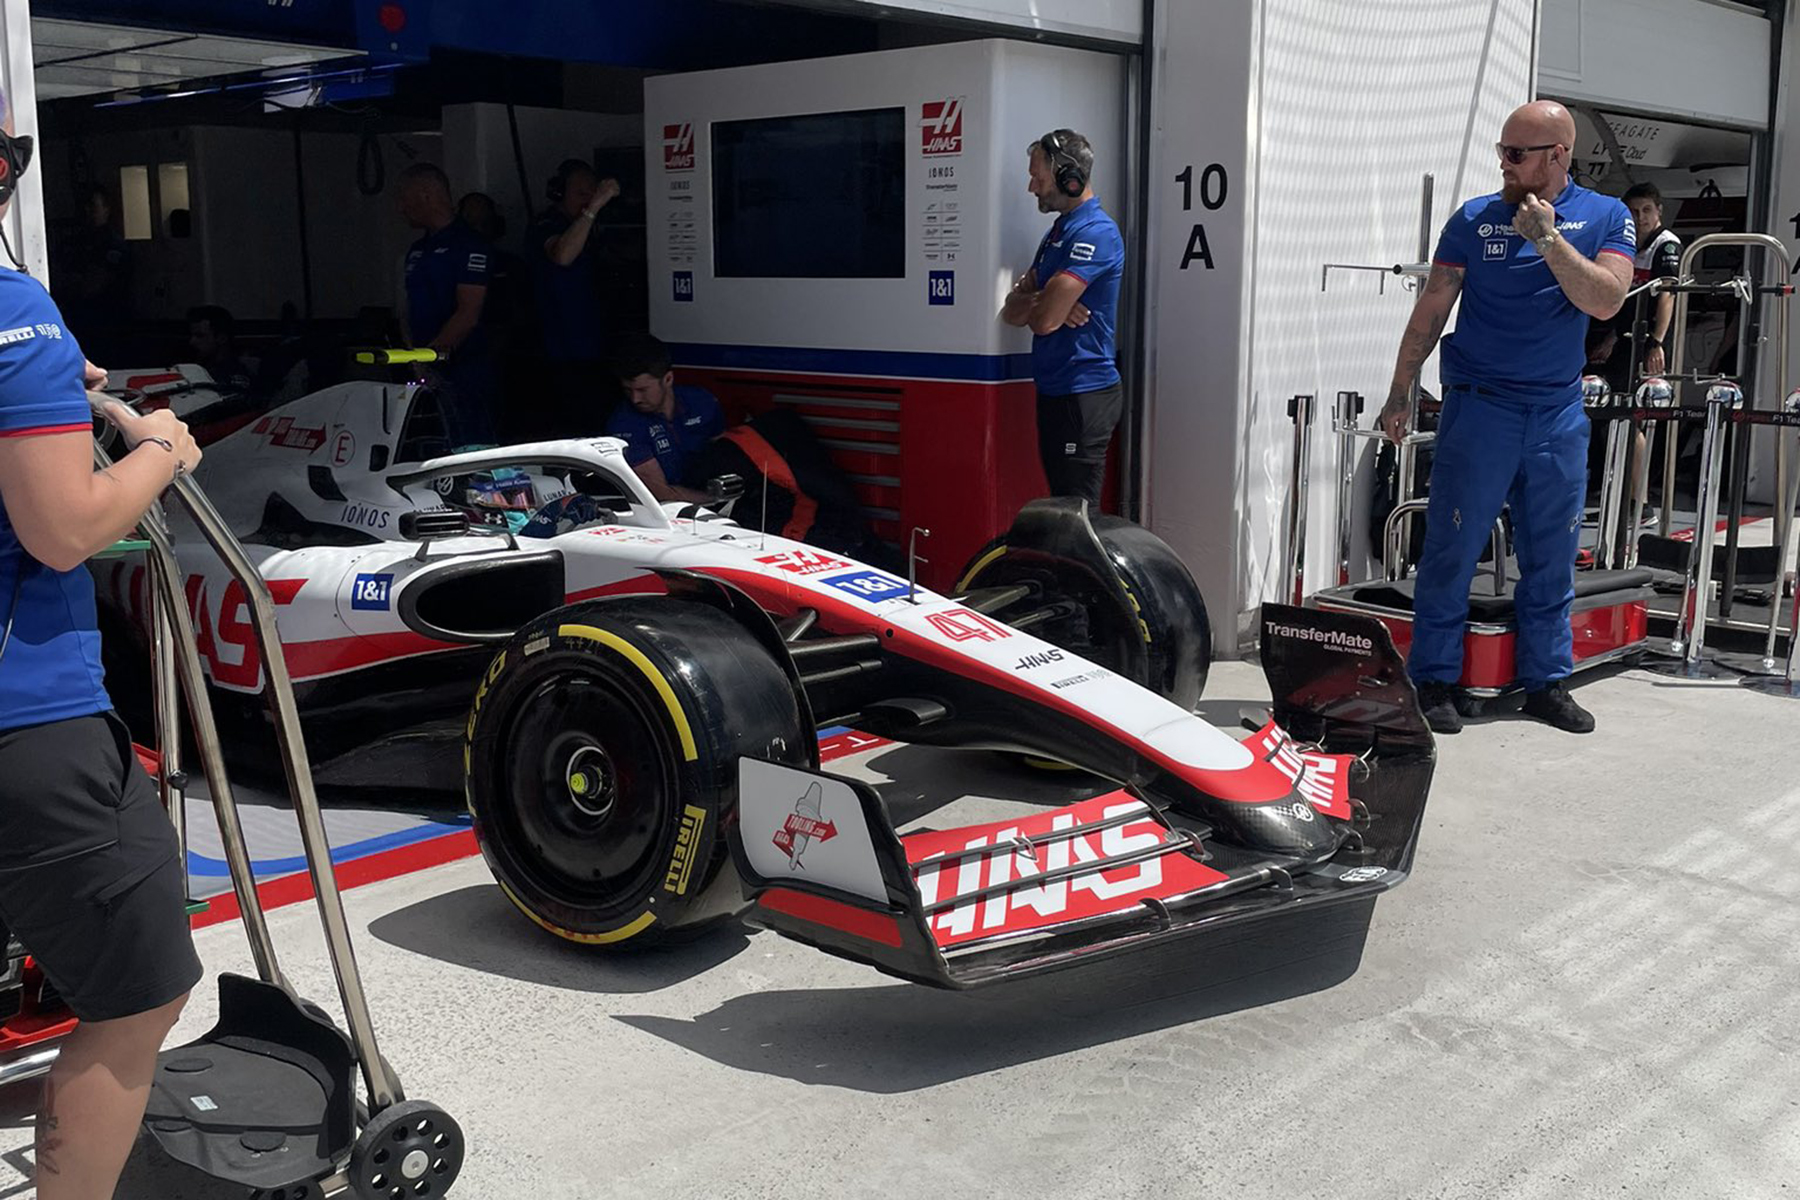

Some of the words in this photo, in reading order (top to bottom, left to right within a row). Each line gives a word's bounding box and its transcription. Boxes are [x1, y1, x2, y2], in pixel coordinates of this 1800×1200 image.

[1175, 163, 1228, 210] 10
[1179, 224, 1215, 269] A
[1487, 243, 1504, 255] 1&1
[930, 278, 952, 297] 1&1
[335, 436, 350, 463] E
[341, 505, 390, 528] IONOS
[357, 580, 388, 601] 1&1
[836, 577, 903, 595] 1&1
[924, 608, 1013, 642] 47
[1265, 621, 1373, 649] TransferMate
[1015, 649, 1065, 670] HAAS
[664, 804, 707, 895] PIRELLI
